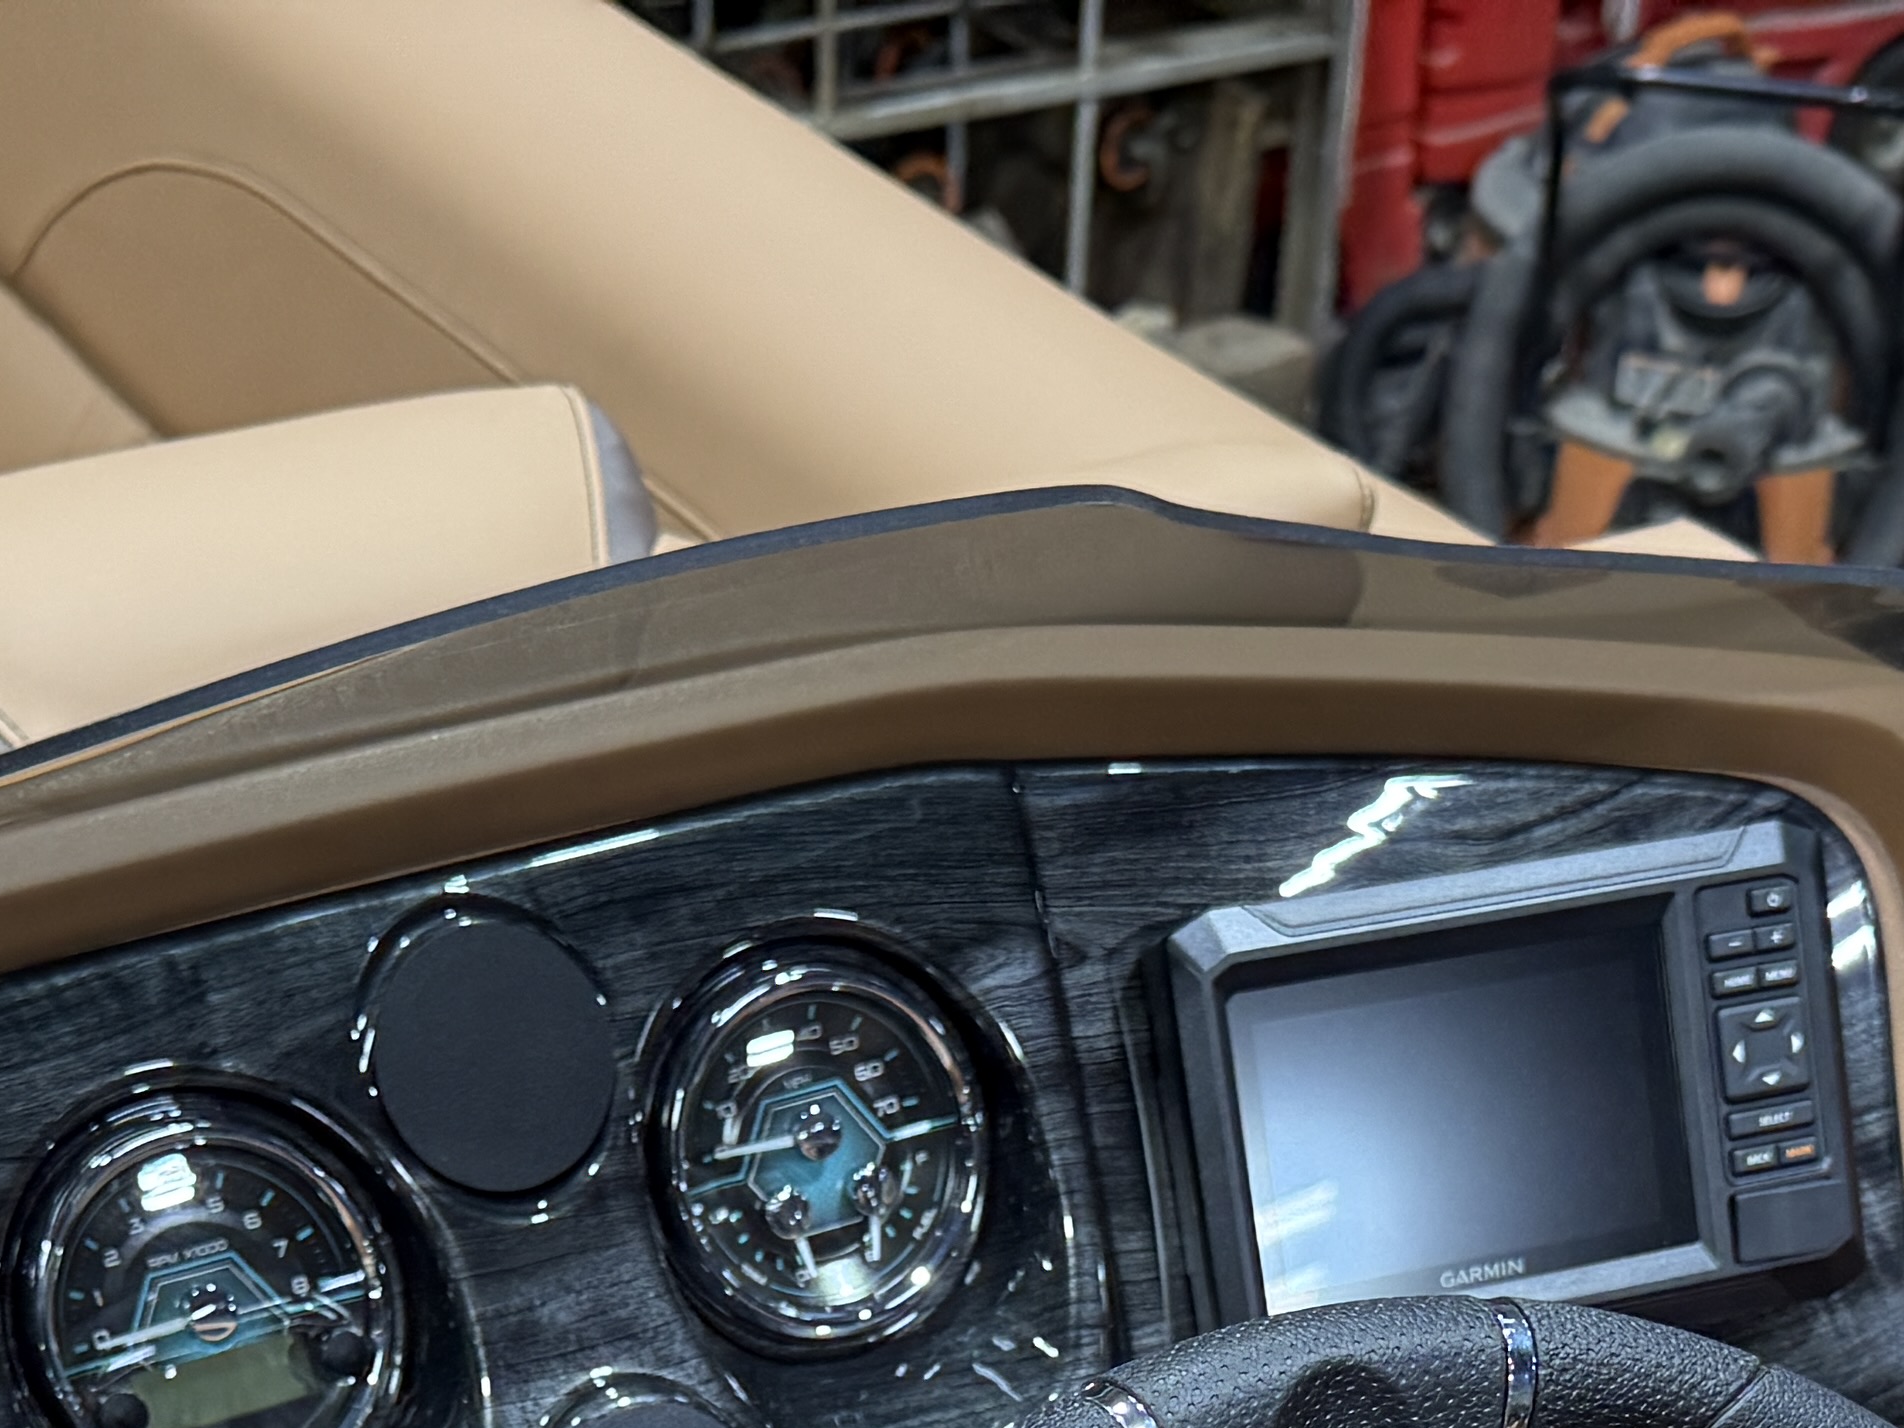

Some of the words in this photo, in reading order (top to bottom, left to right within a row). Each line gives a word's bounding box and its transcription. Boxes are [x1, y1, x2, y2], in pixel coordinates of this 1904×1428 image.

[206, 1197, 225, 1214] 5
[128, 1217, 146, 1236] 3
[242, 1211, 263, 1231] 6
[272, 1237, 289, 1258] 7
[103, 1249, 122, 1269] 2
[1440, 1257, 1526, 1288] GARMIN
